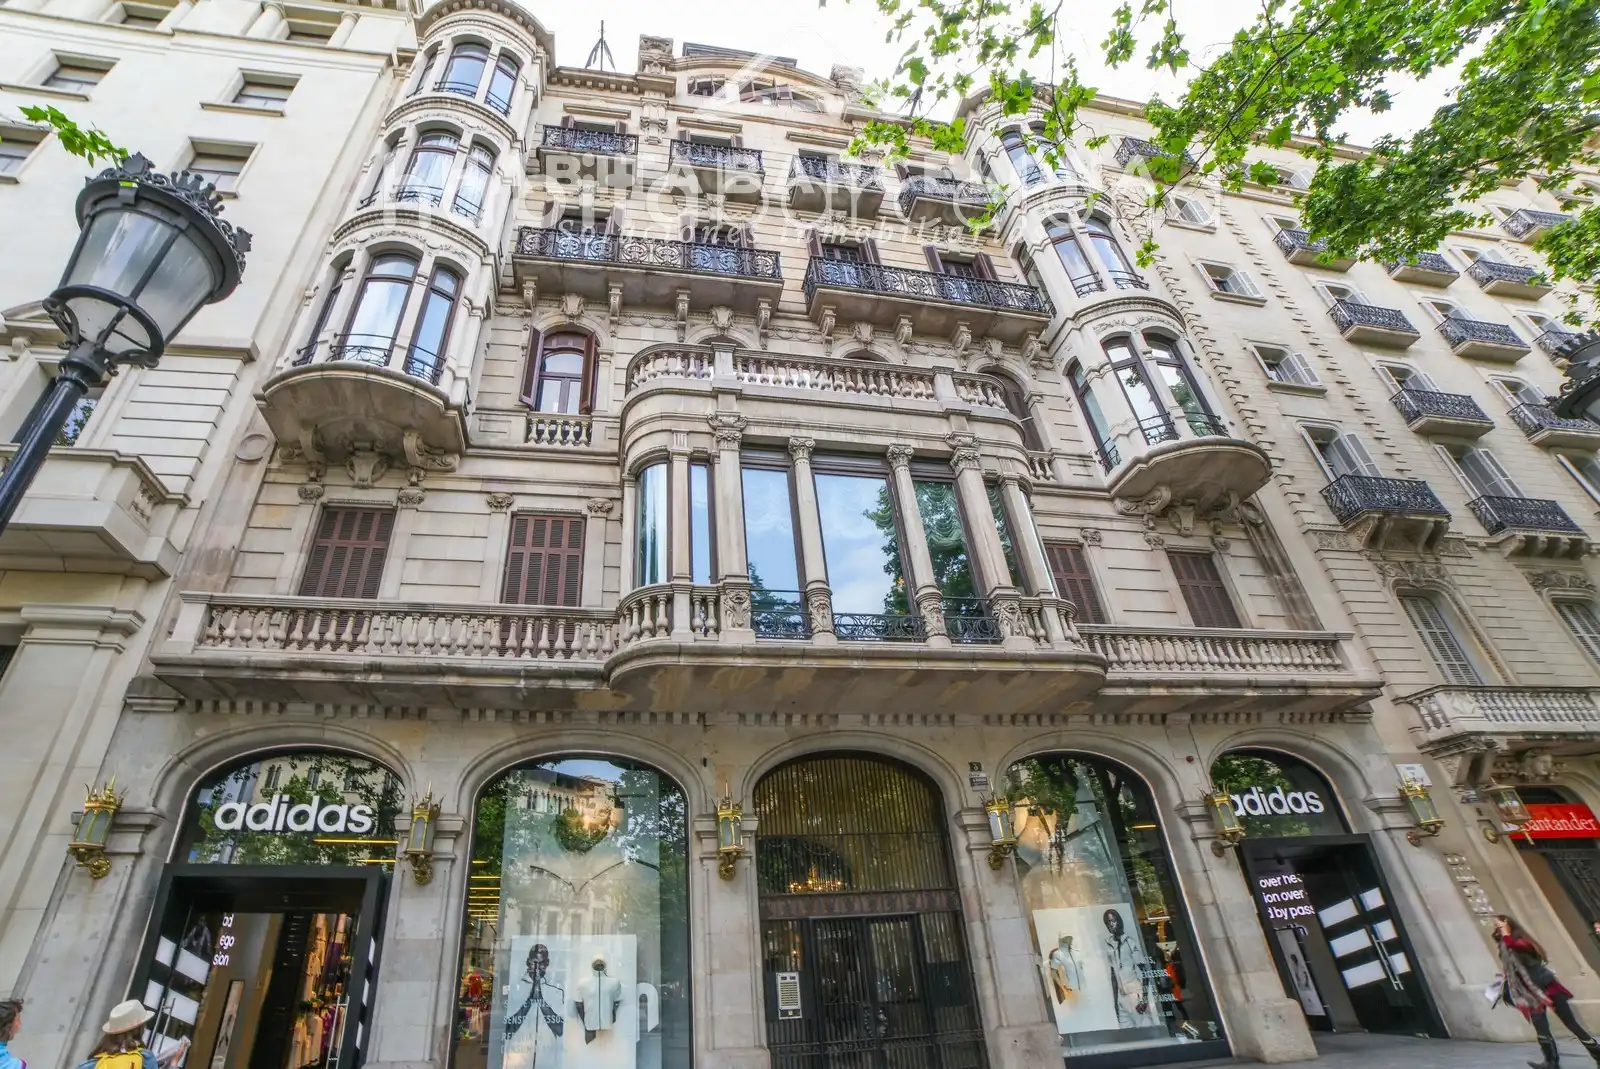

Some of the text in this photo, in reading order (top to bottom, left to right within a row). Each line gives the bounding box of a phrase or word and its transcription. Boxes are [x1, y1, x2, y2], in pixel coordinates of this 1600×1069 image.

[214, 794, 373, 833] adidas
[1259, 876, 1282, 888] over
[1280, 889, 1305, 901] over
[1273, 906, 1288, 920] by
